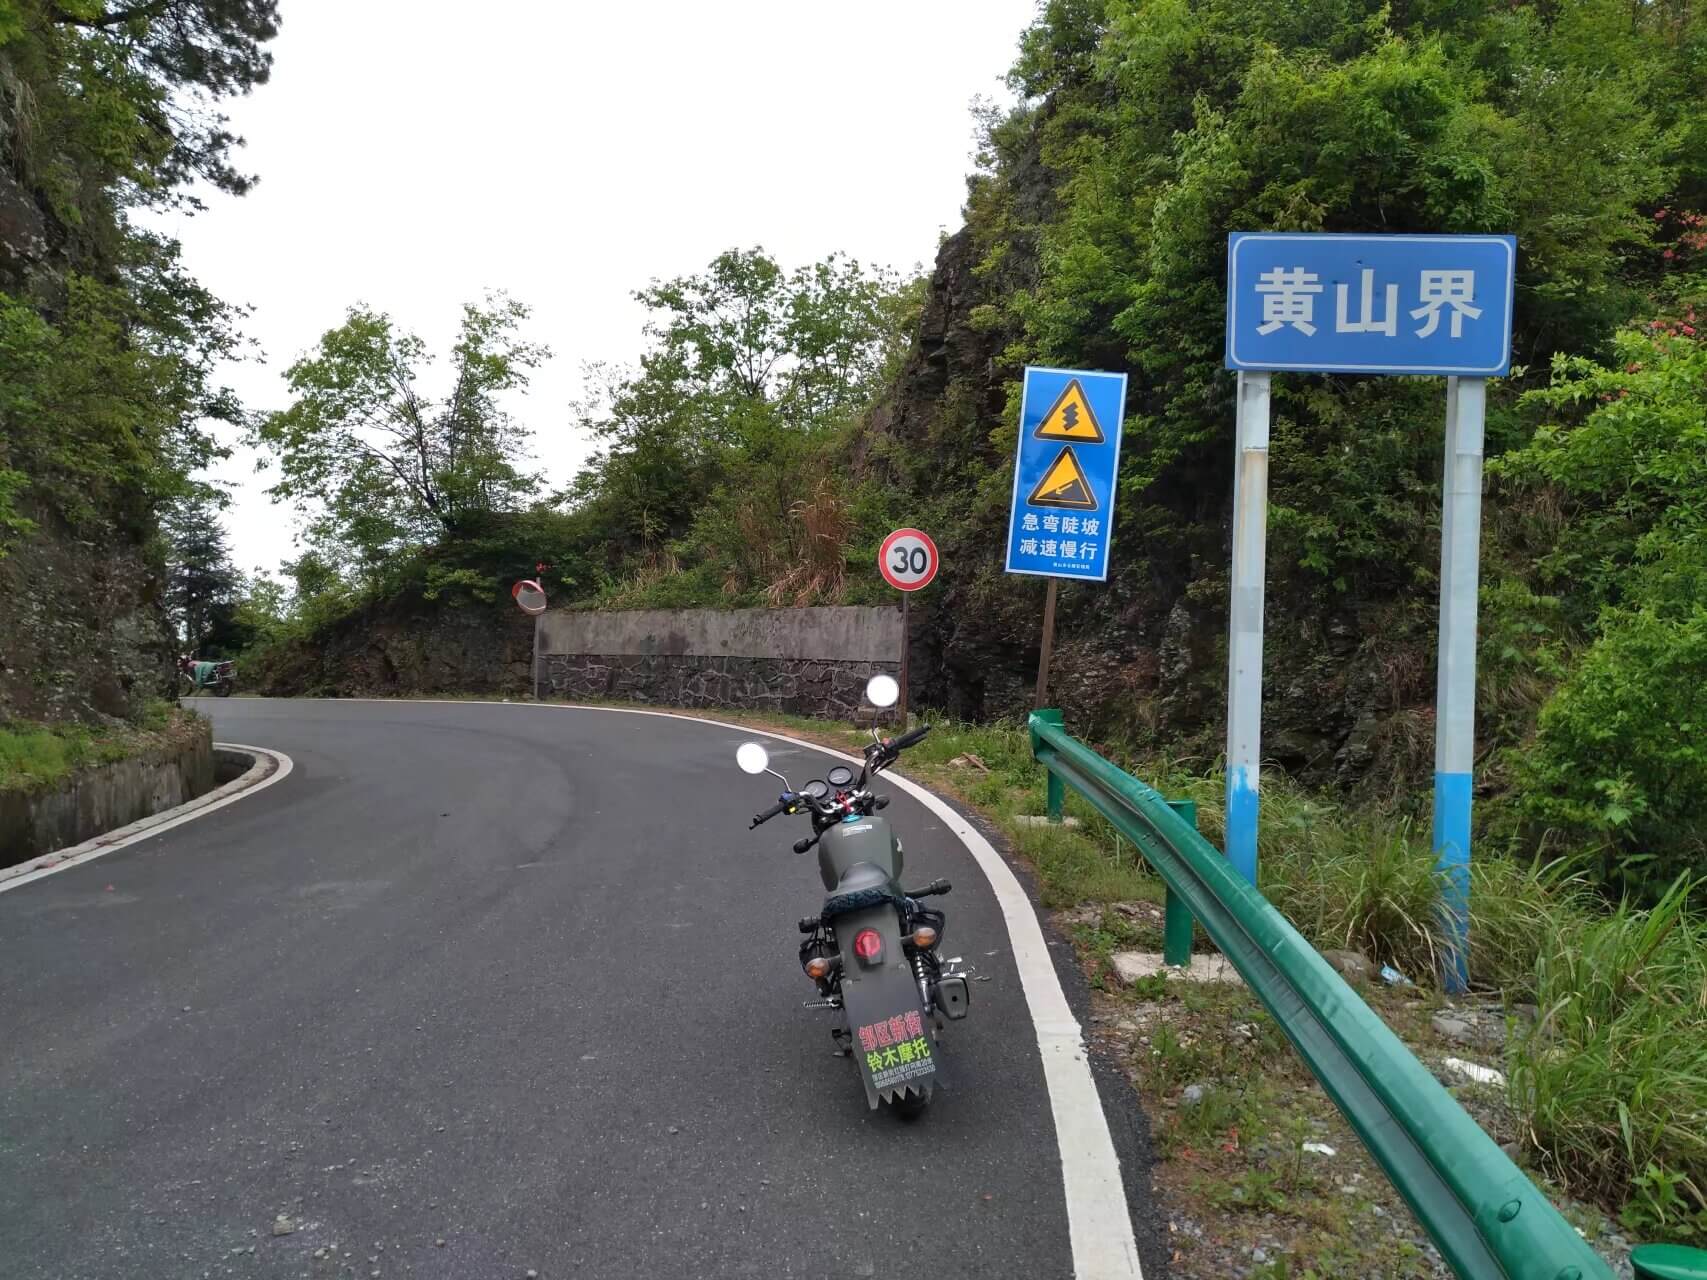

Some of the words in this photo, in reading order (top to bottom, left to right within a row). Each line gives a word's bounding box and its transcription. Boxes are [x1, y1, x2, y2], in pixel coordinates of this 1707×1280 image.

[1254, 267, 1483, 338] 黄山界
[1021, 513, 1100, 536] 急弯陡坡
[892, 546, 927, 574] 30
[1019, 538, 1098, 560] 减速慢行
[867, 1036, 930, 1072] 铃木摩托
